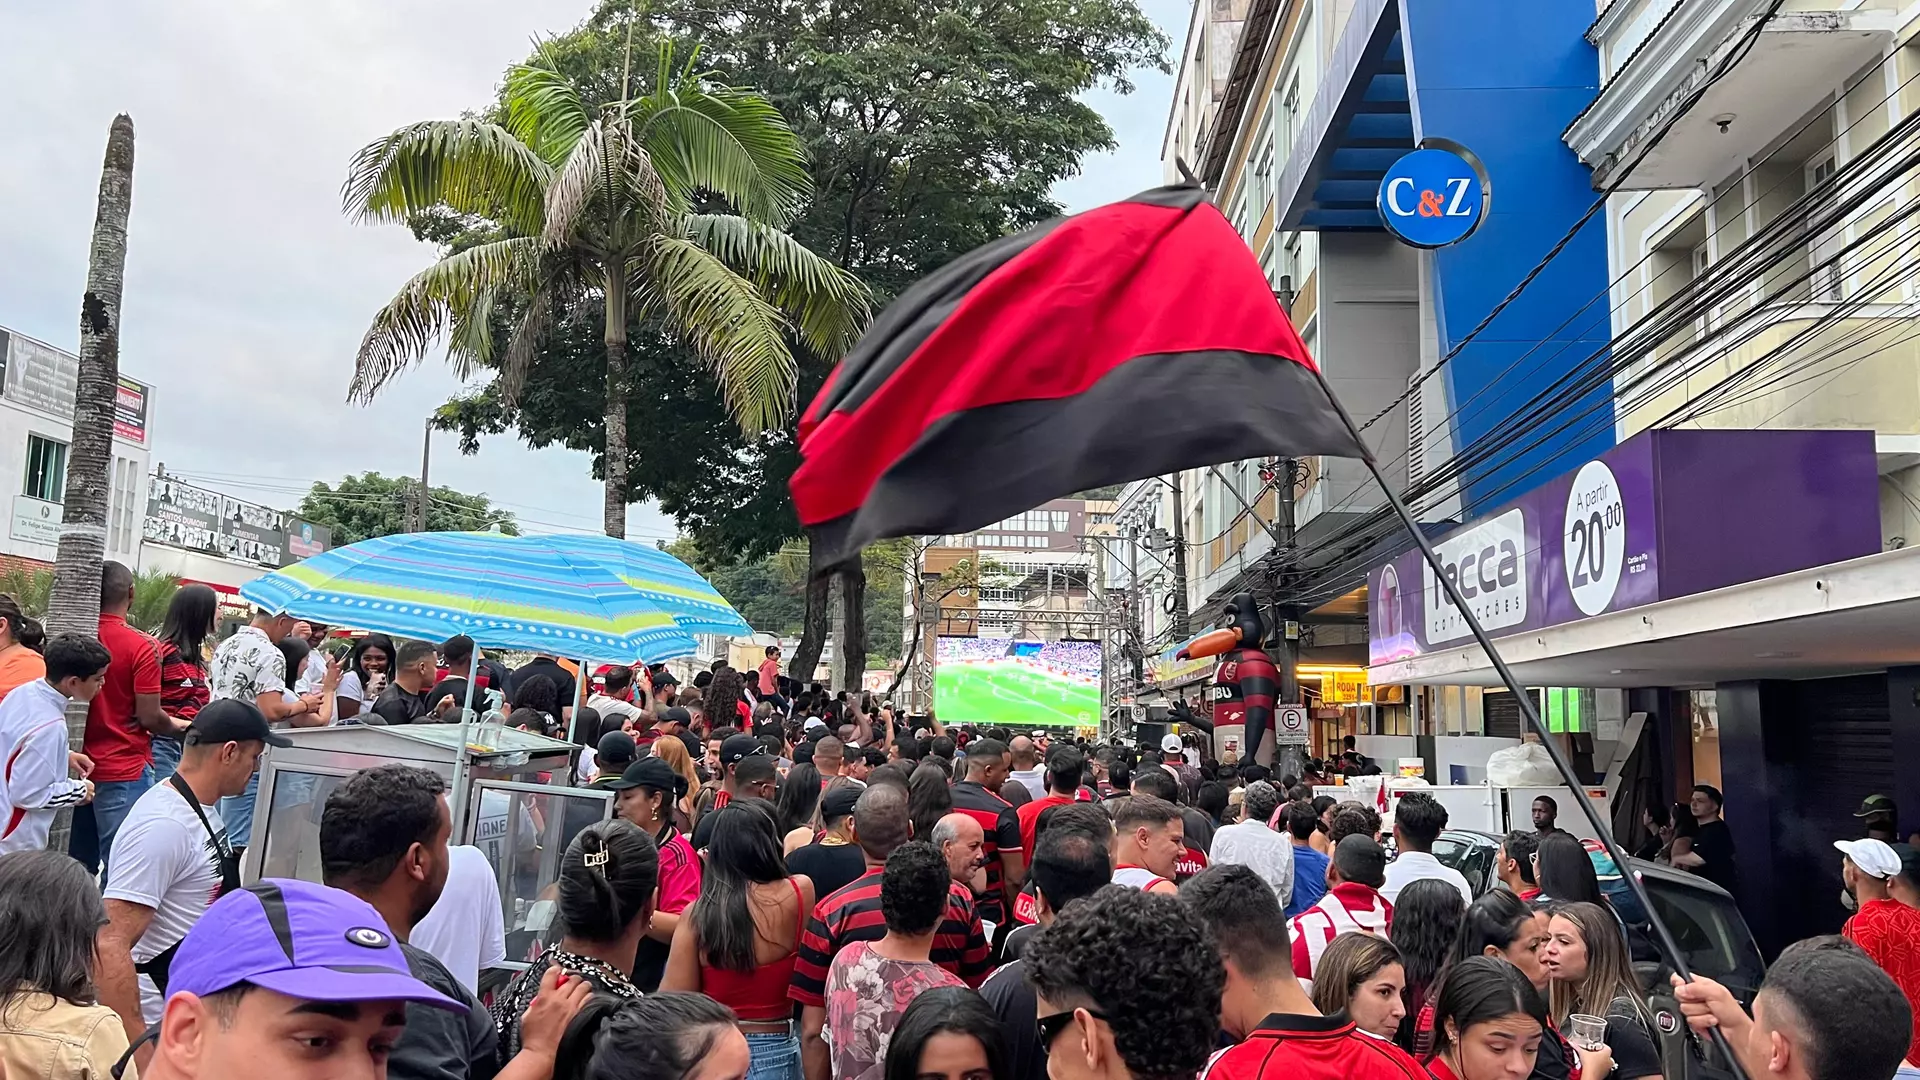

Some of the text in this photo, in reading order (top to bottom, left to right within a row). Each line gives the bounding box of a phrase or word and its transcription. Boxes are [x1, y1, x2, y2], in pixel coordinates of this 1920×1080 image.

[1386, 177, 1472, 217] C&Z
[1585, 481, 1608, 512] partir
[158, 510, 207, 529] SANTOS DUMONT
[1571, 501, 1621, 589] 20,00
[1337, 682, 1355, 692] RODA
[1287, 713, 1295, 726] E
